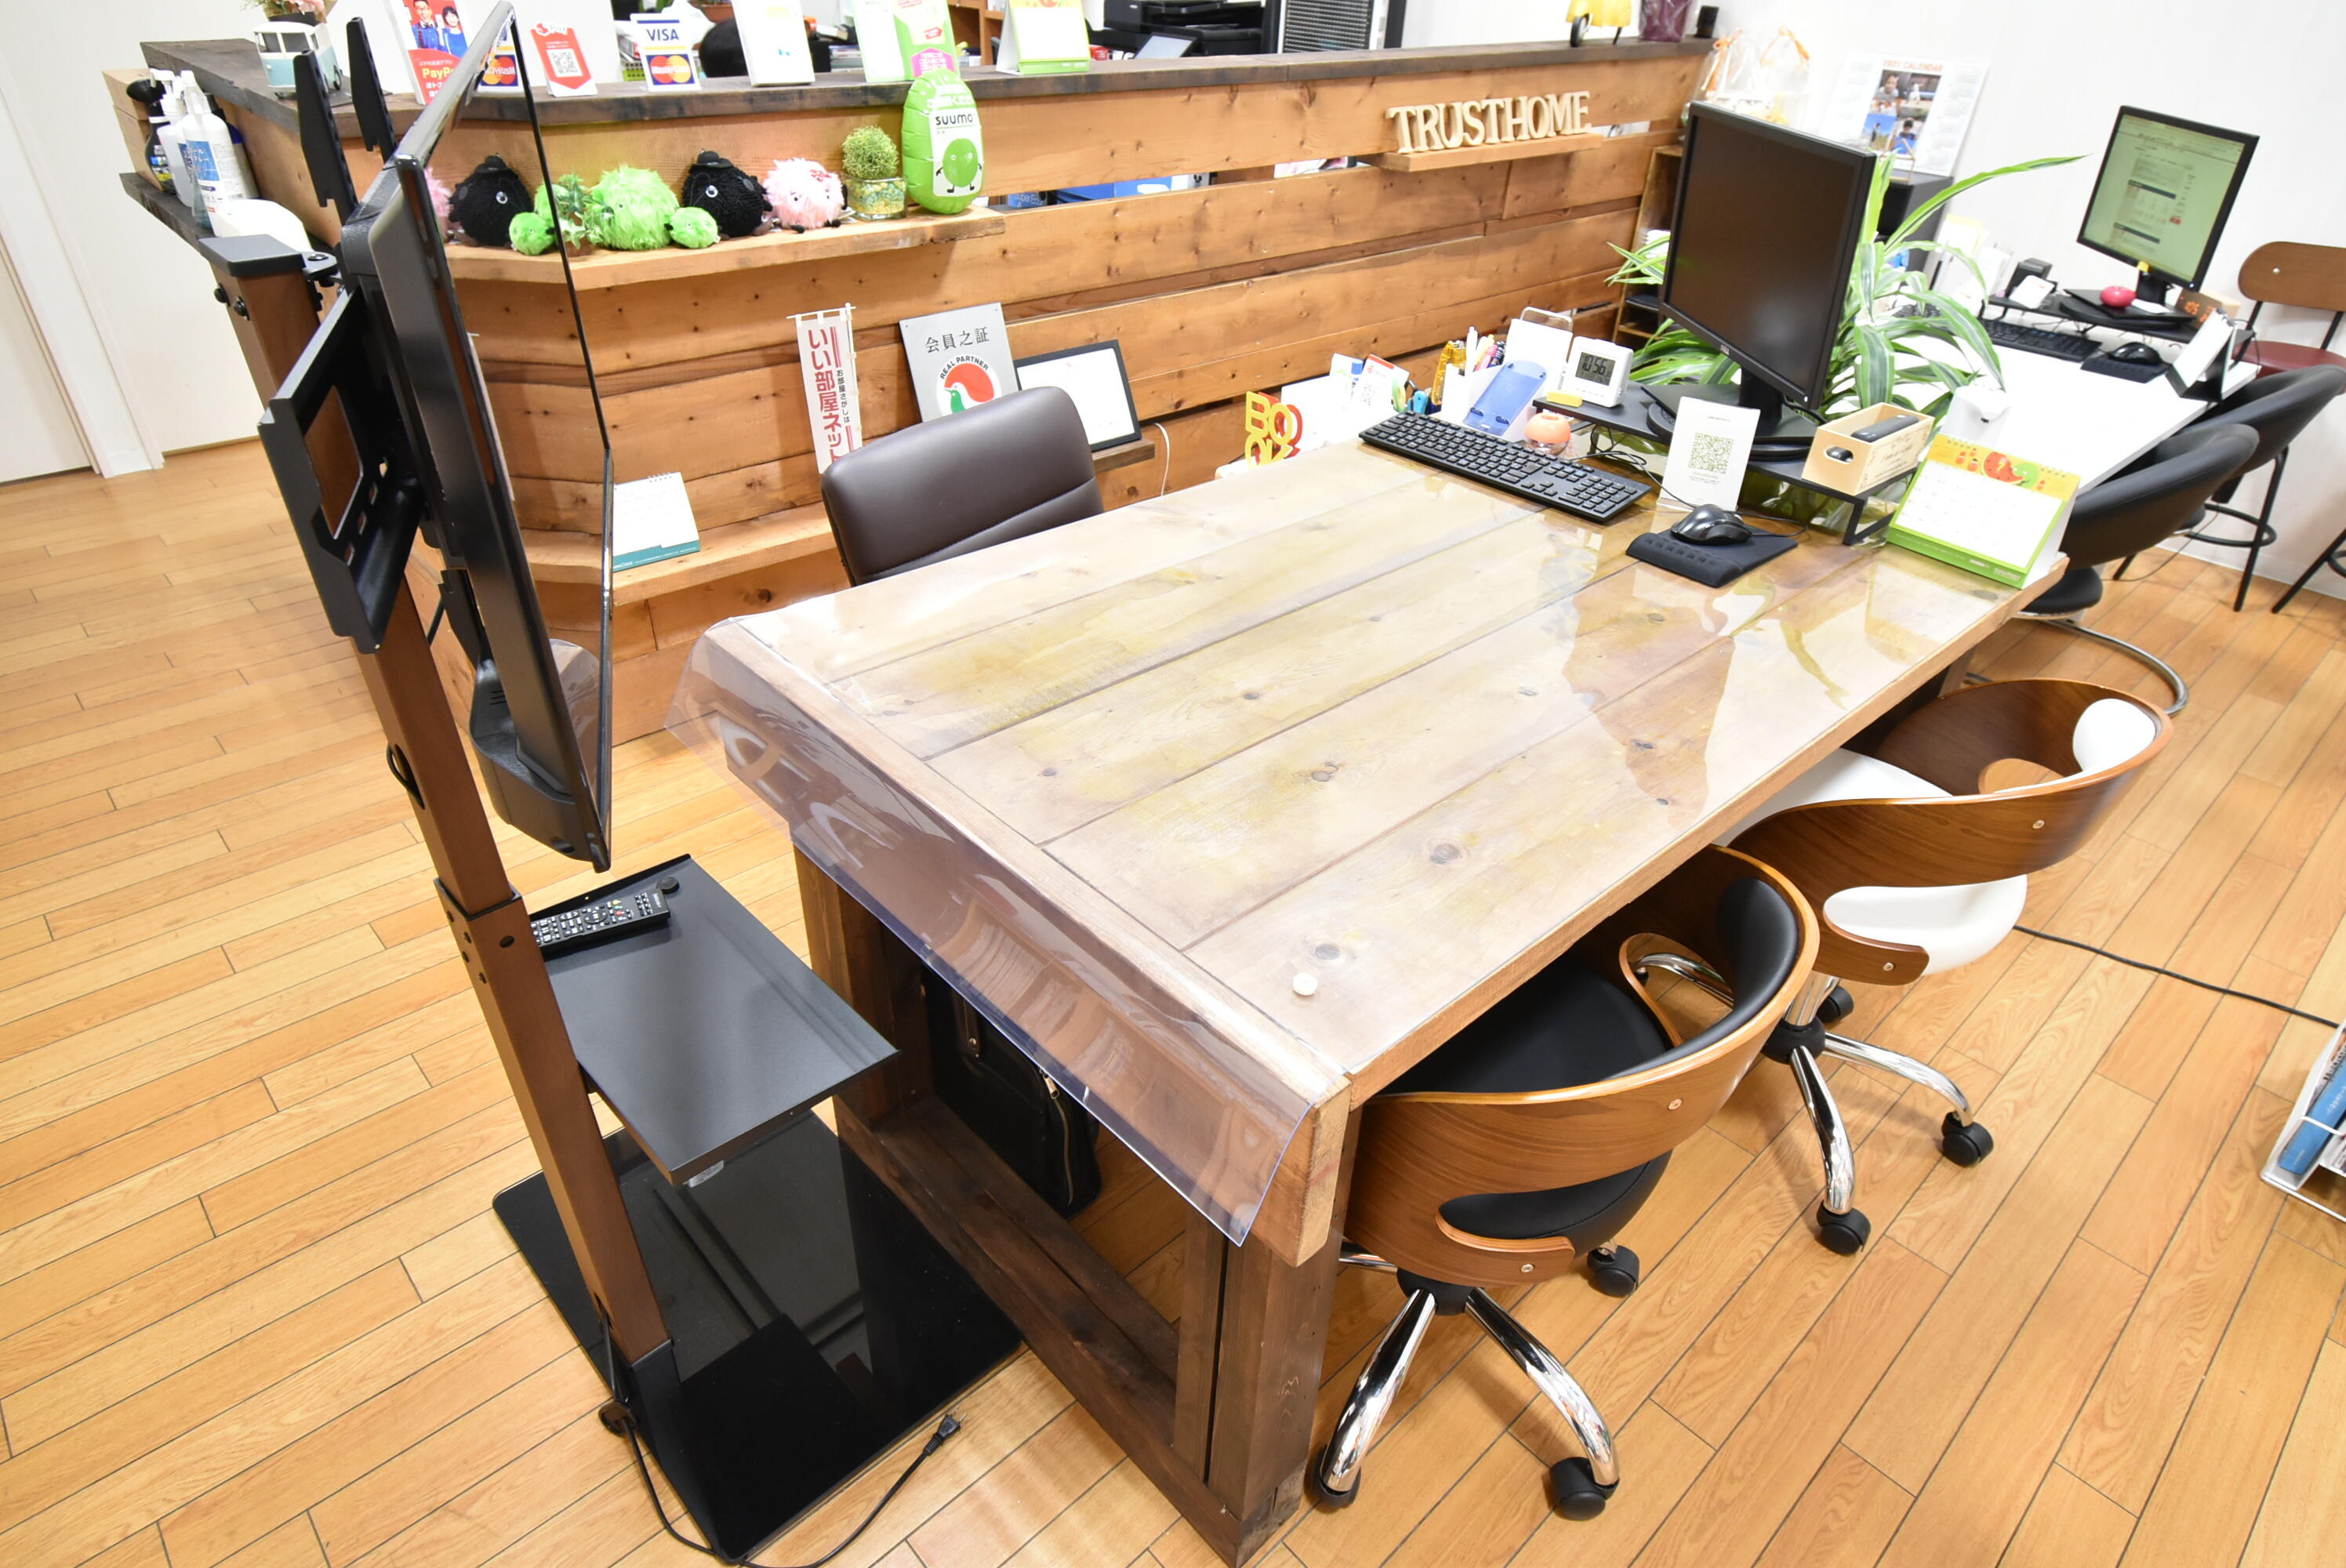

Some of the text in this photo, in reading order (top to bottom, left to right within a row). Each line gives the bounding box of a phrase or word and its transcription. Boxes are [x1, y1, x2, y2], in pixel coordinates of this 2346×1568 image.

[646, 28, 680, 42] VISA
[1385, 91, 1592, 154] TRUSTHOME
[925, 326, 990, 354] 会員之証
[939, 355, 990, 380] REAL PARTNER
[807, 328, 843, 463] いい部屋ネット
[836, 369, 851, 423] お部屋さがしは
